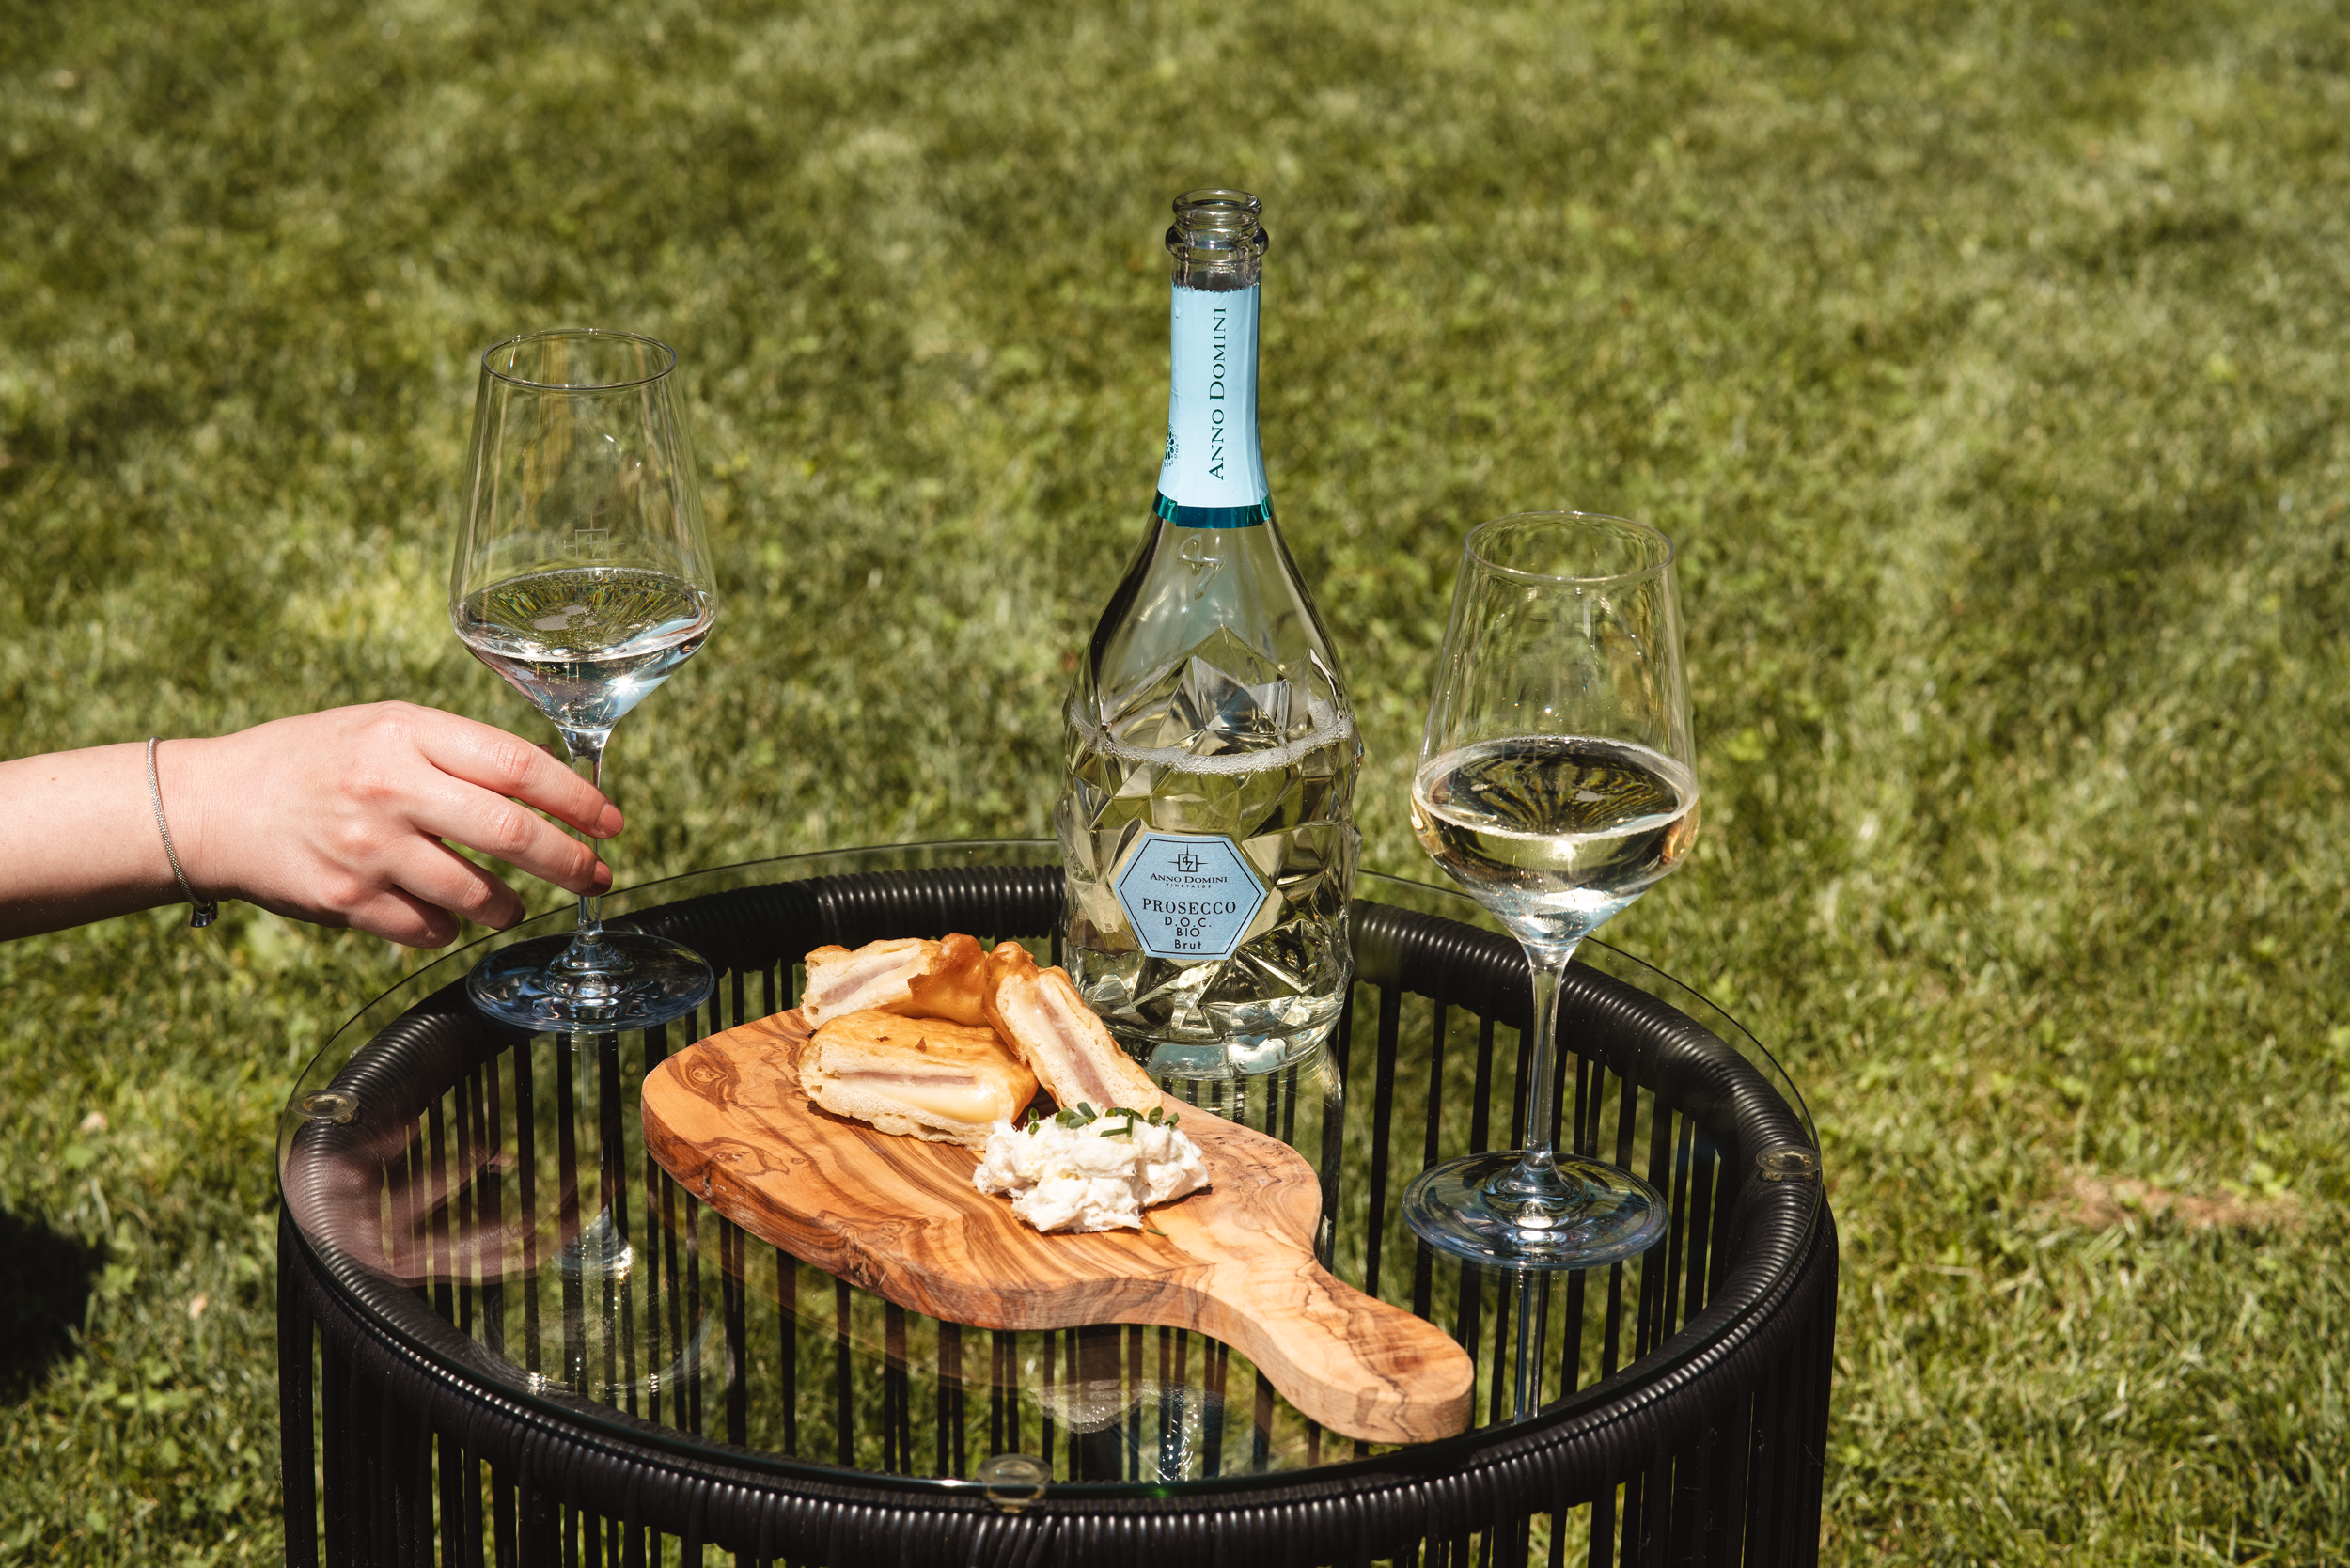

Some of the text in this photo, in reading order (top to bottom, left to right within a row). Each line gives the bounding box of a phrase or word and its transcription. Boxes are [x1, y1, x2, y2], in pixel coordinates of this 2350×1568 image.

[1208, 306, 1227, 480] ANNO DOMINI
[1150, 872, 1228, 884] ANNO DOMINI
[1142, 898, 1236, 915] PROSECCO
[1165, 917, 1212, 928] D.O.C.
[1176, 928, 1200, 937] BIO
[1174, 939, 1202, 949] Brut
